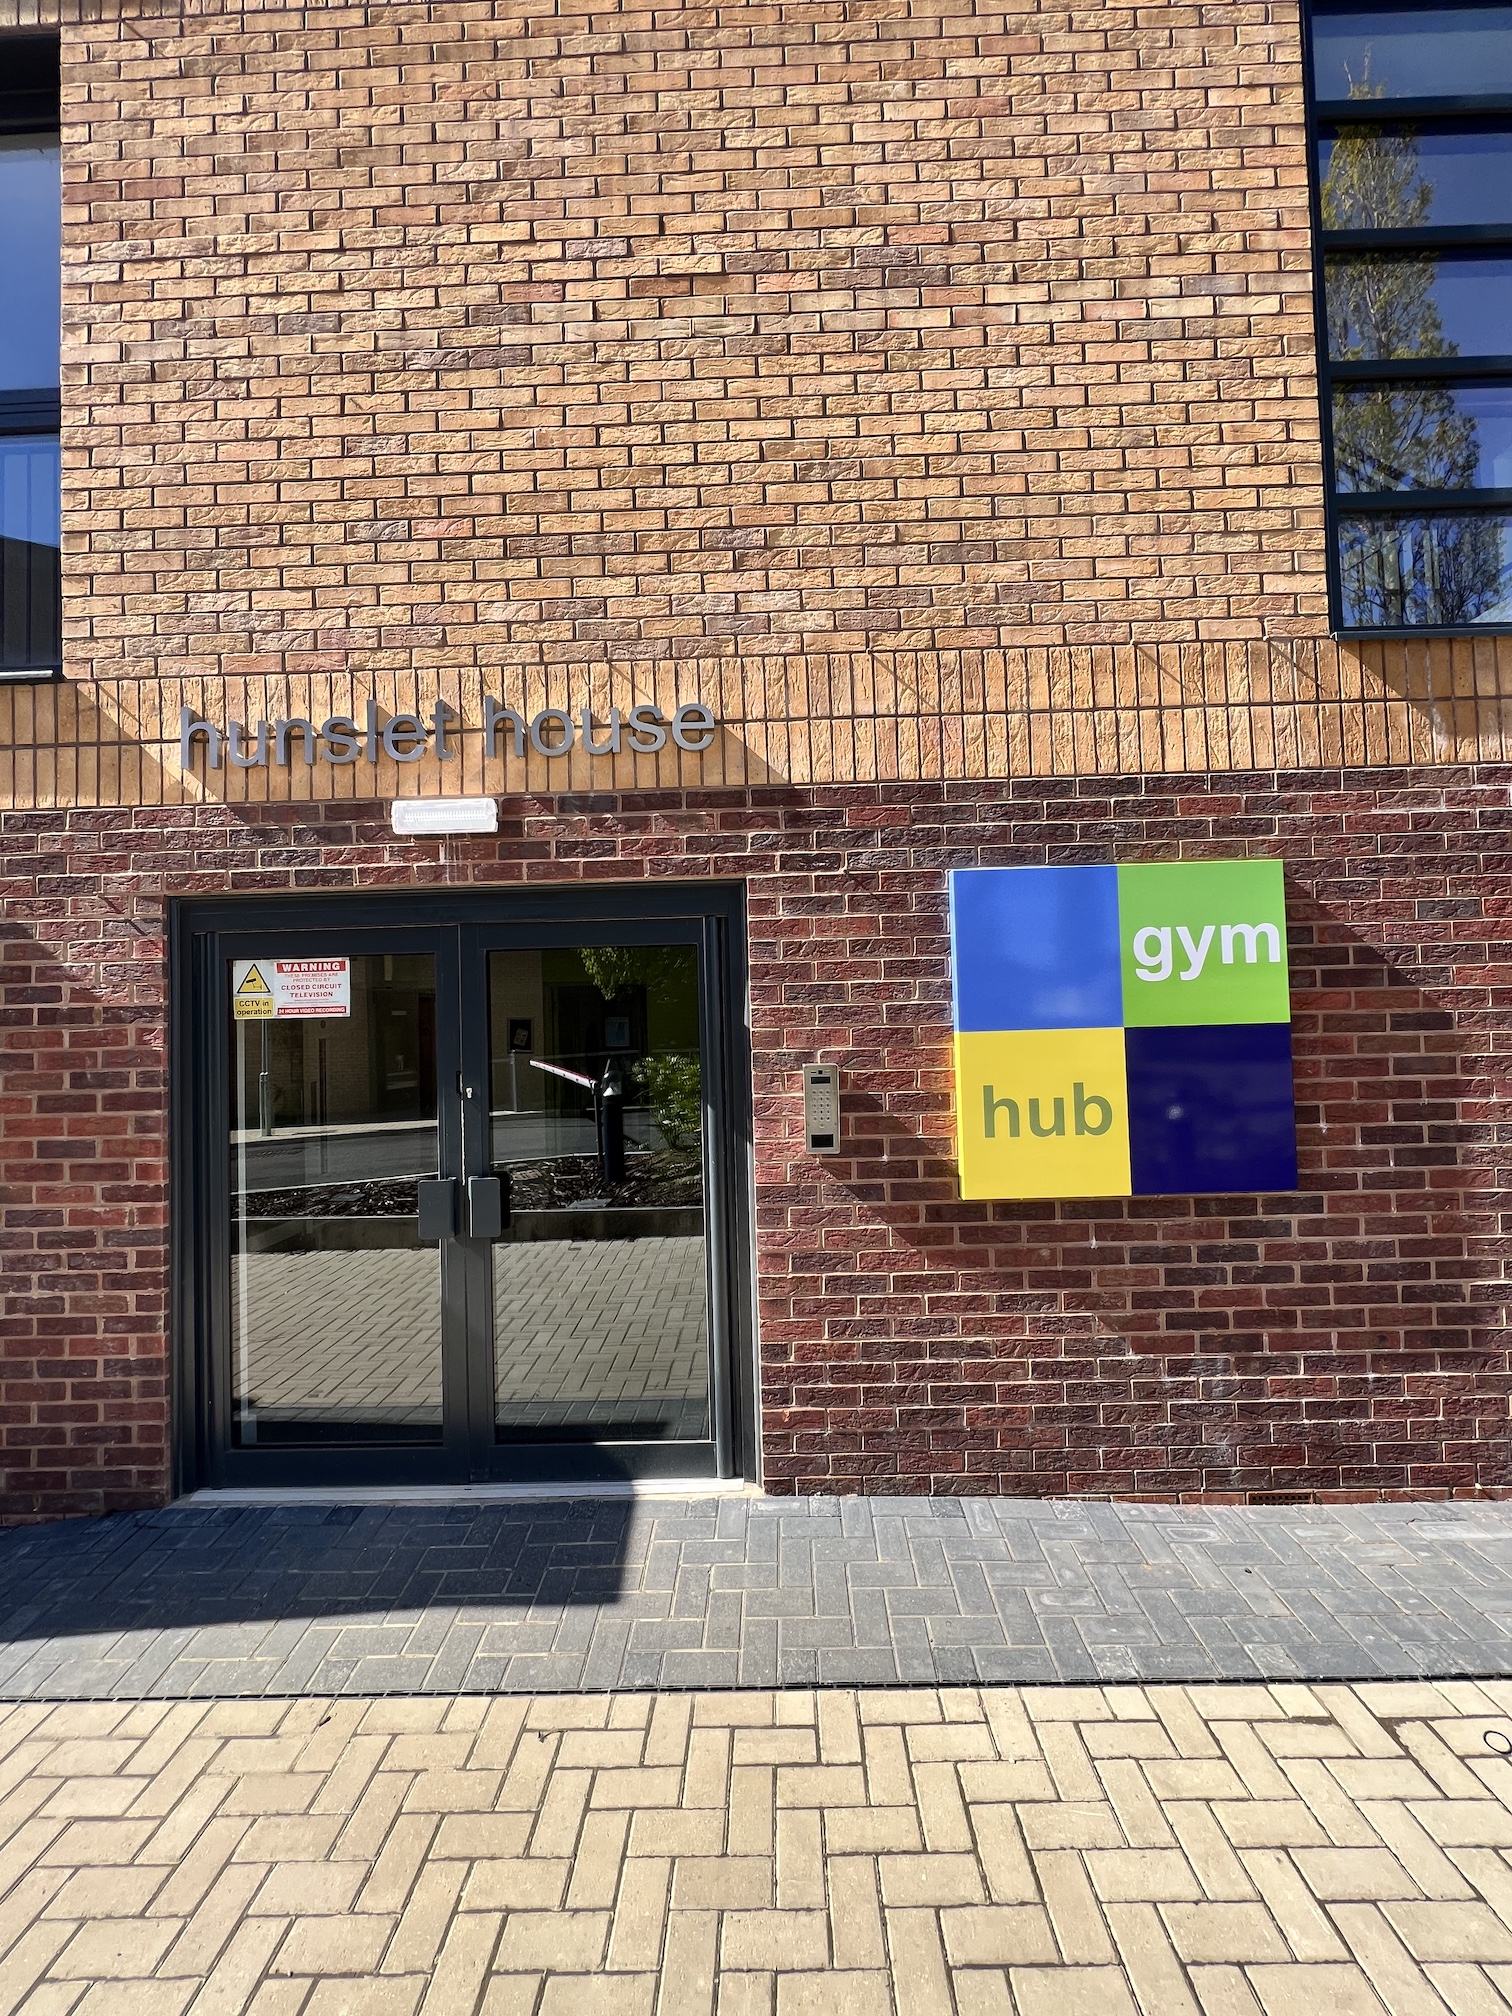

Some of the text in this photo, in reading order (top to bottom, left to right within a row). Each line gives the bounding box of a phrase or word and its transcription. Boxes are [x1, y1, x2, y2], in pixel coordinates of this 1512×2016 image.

[181, 695, 716, 770] hunslet house
[281, 962, 341, 973] WARNING
[1133, 922, 1281, 982] gym
[236, 1008, 272, 1017] operation
[315, 1006, 346, 1014] RECORDING
[982, 1082, 1113, 1139] hub
